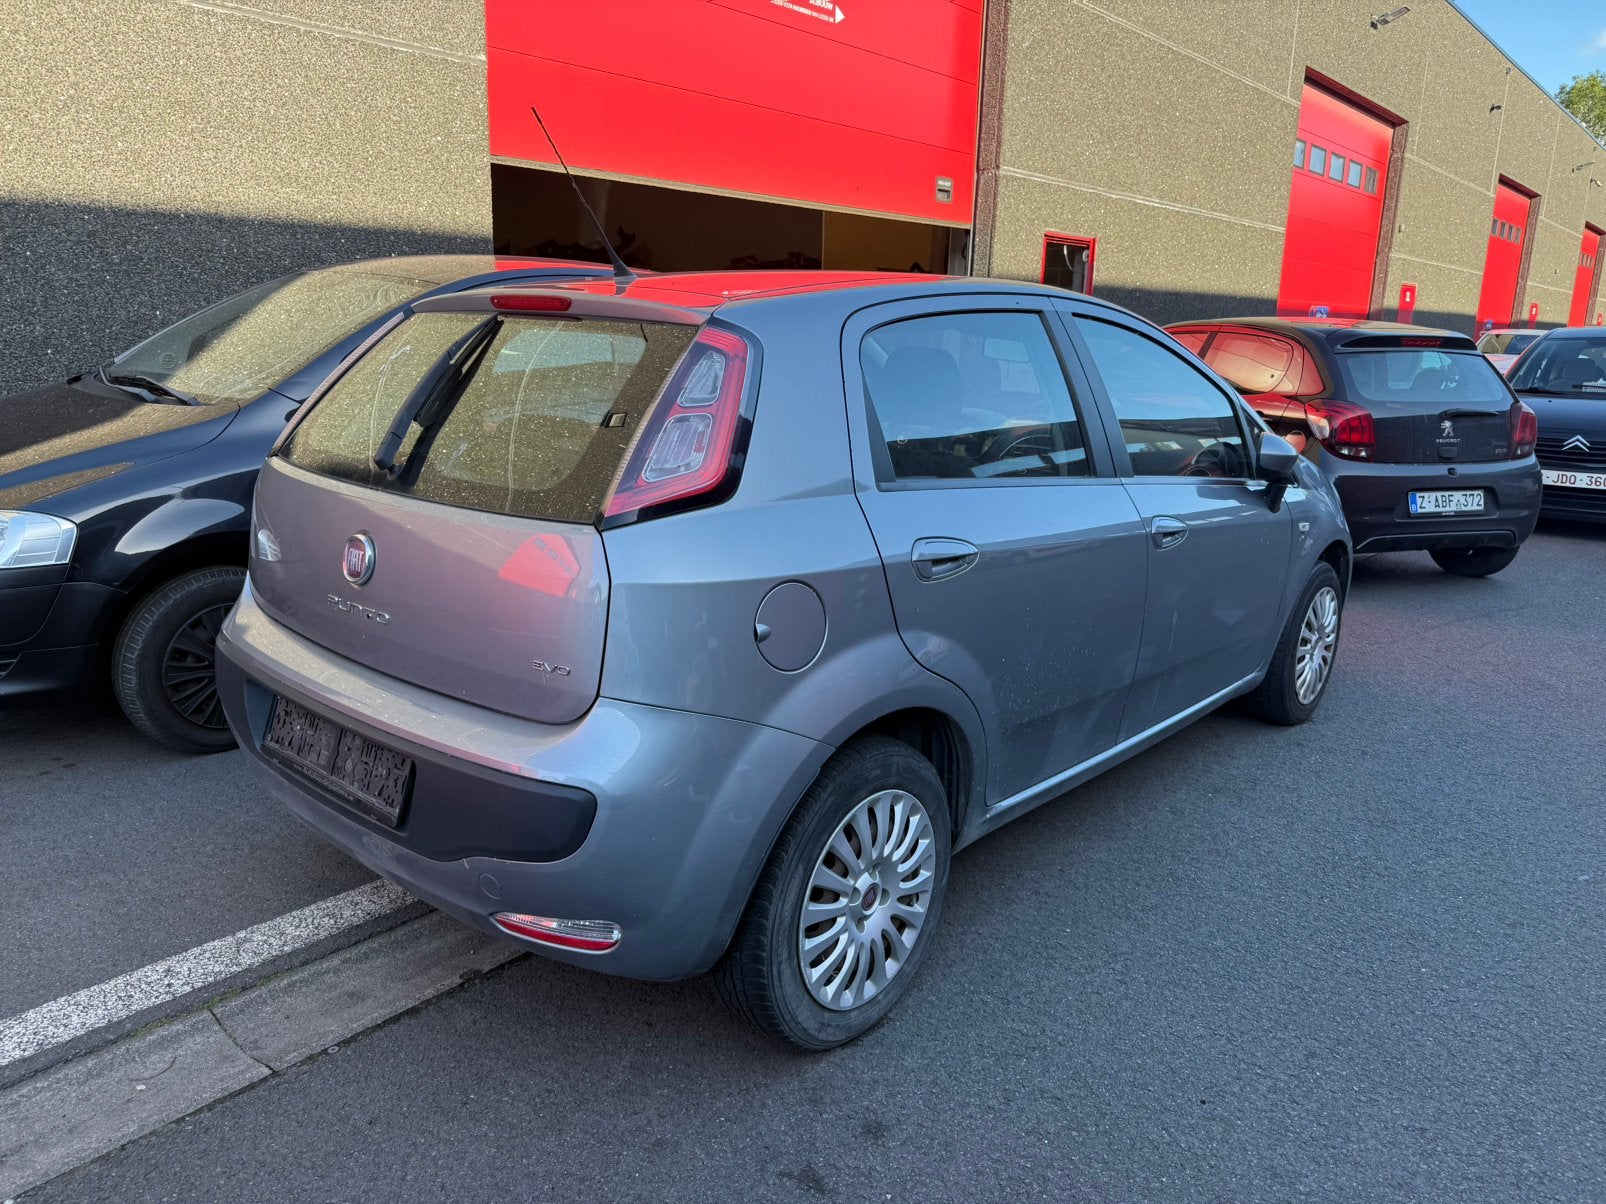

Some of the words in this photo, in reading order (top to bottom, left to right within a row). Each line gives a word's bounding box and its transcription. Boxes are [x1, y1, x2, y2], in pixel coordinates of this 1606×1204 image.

[347, 547, 365, 572] FIAT
[327, 593, 391, 625] PUNTO
[531, 659, 572, 677] EVO
